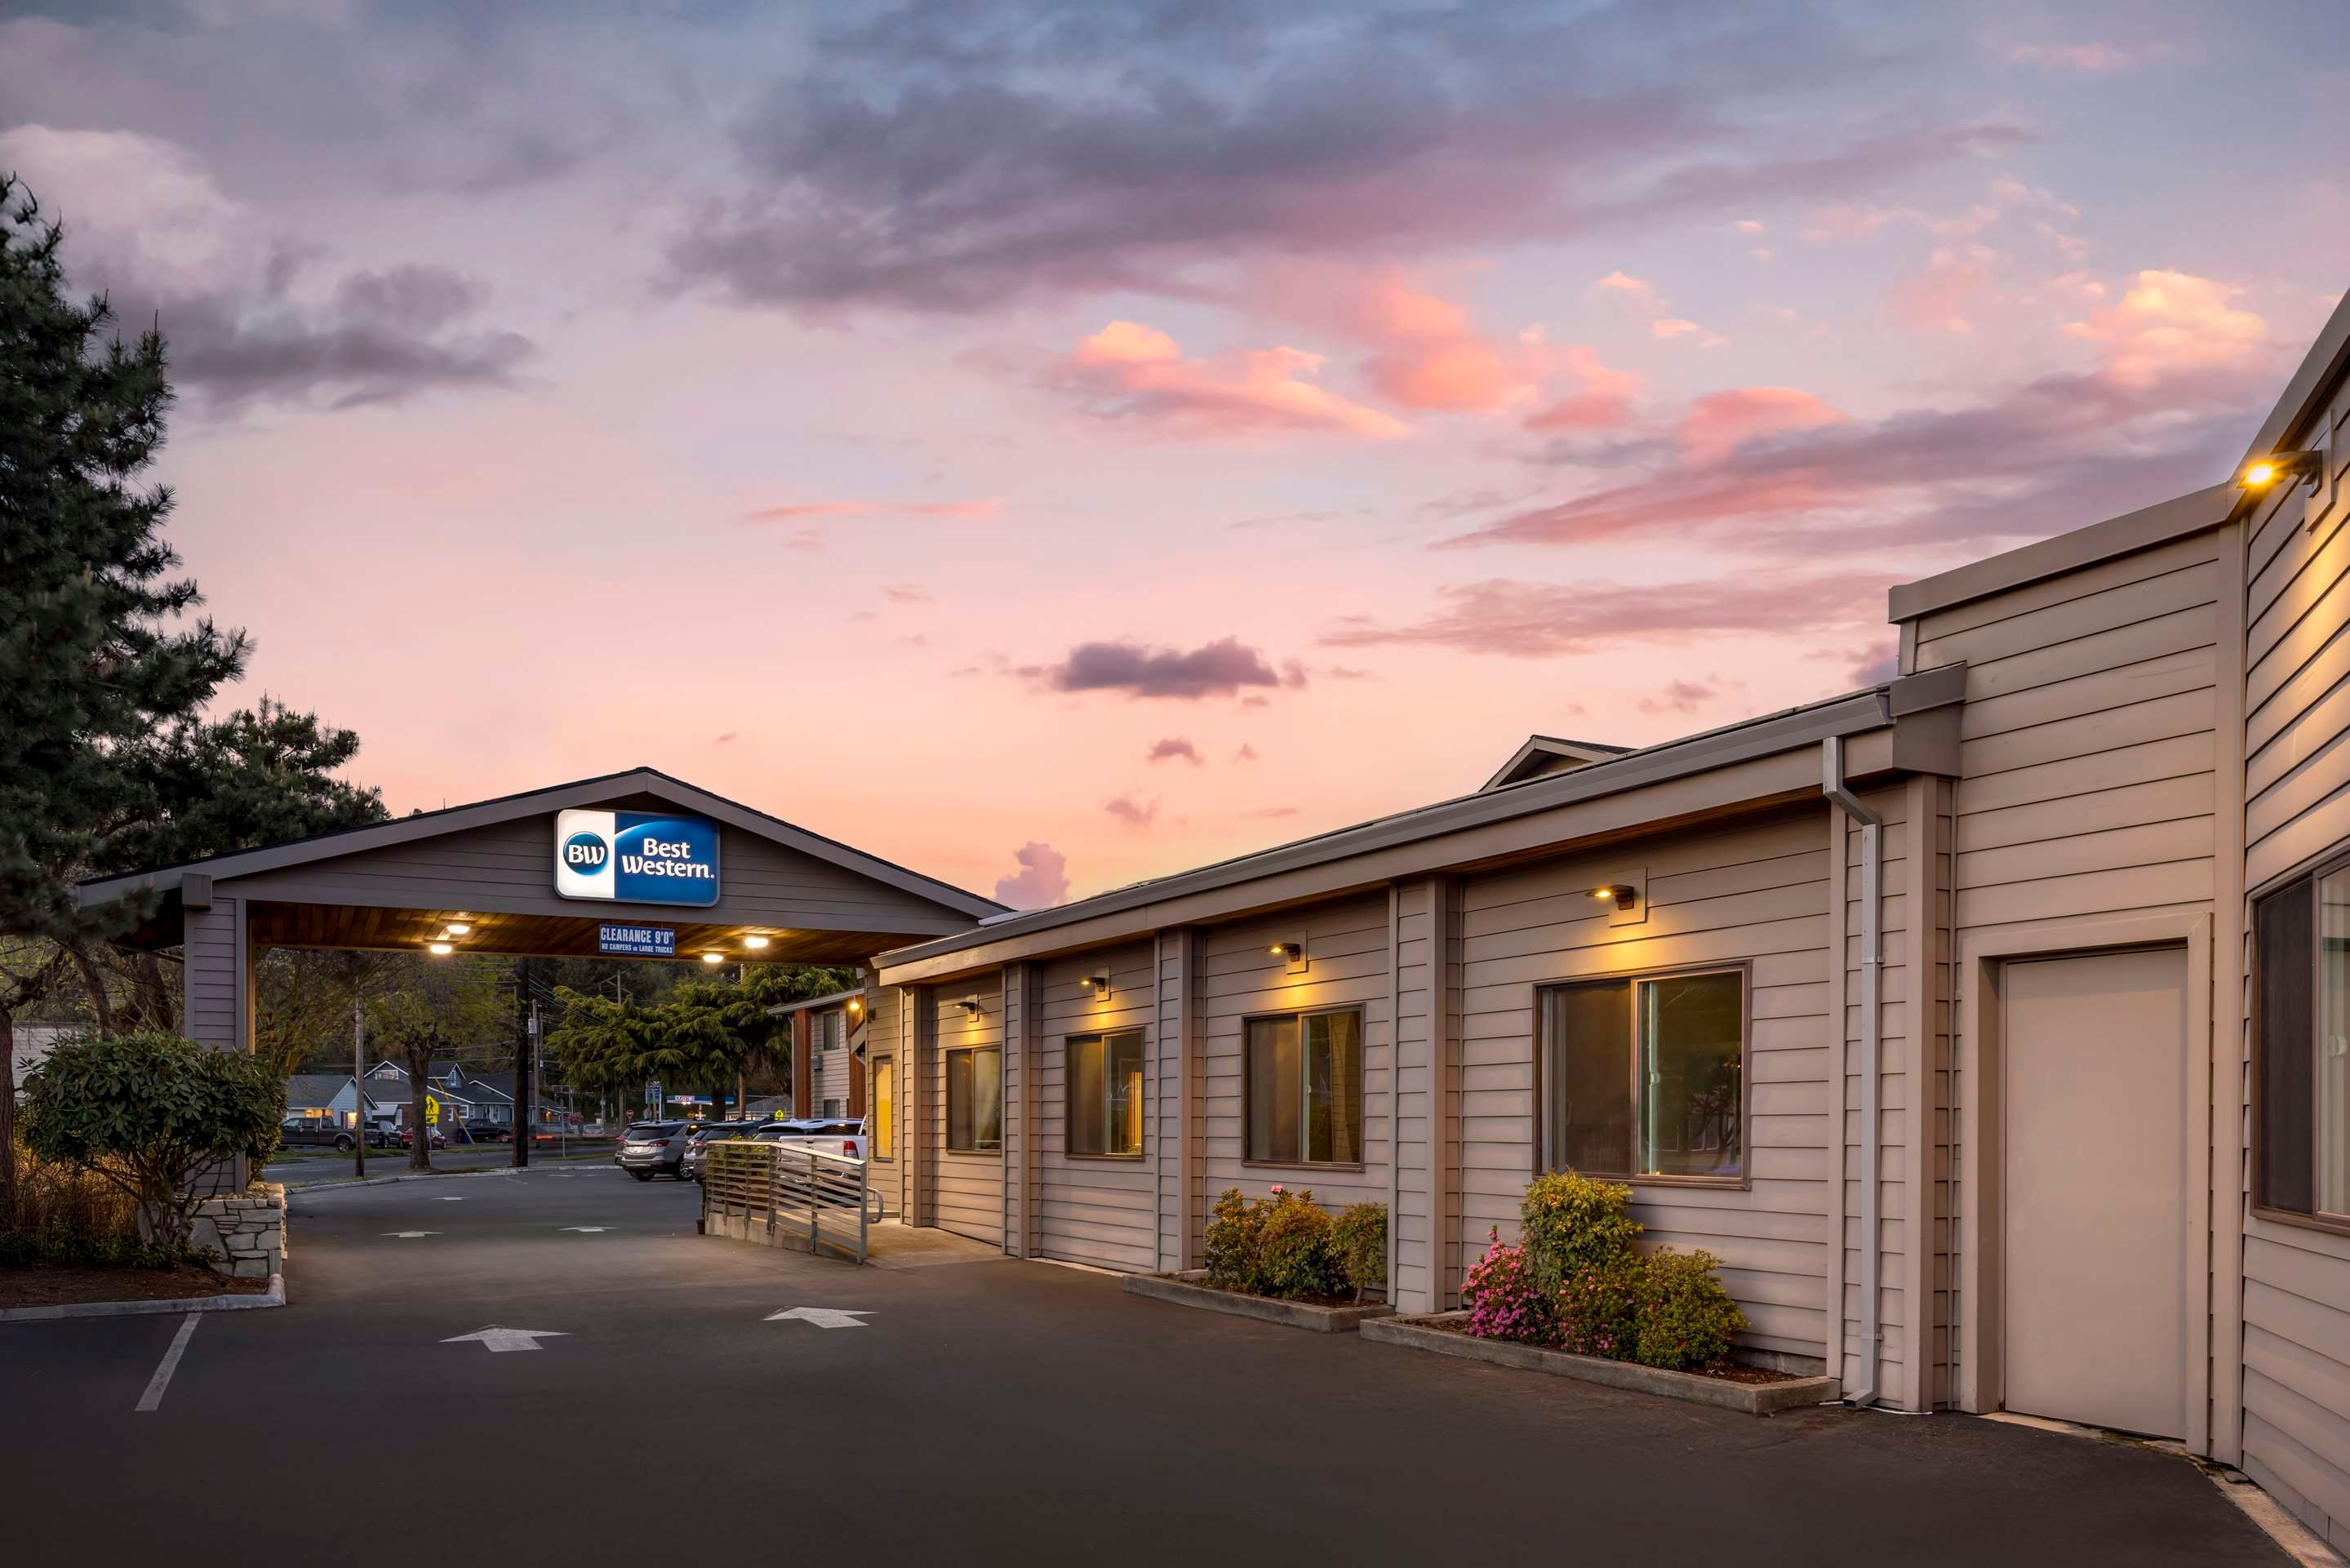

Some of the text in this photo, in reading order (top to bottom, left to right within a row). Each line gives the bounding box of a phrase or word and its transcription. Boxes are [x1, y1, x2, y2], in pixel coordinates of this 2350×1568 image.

[568, 845, 605, 864] BW
[643, 838, 691, 858] Best
[601, 927, 651, 944] CLEARANCE
